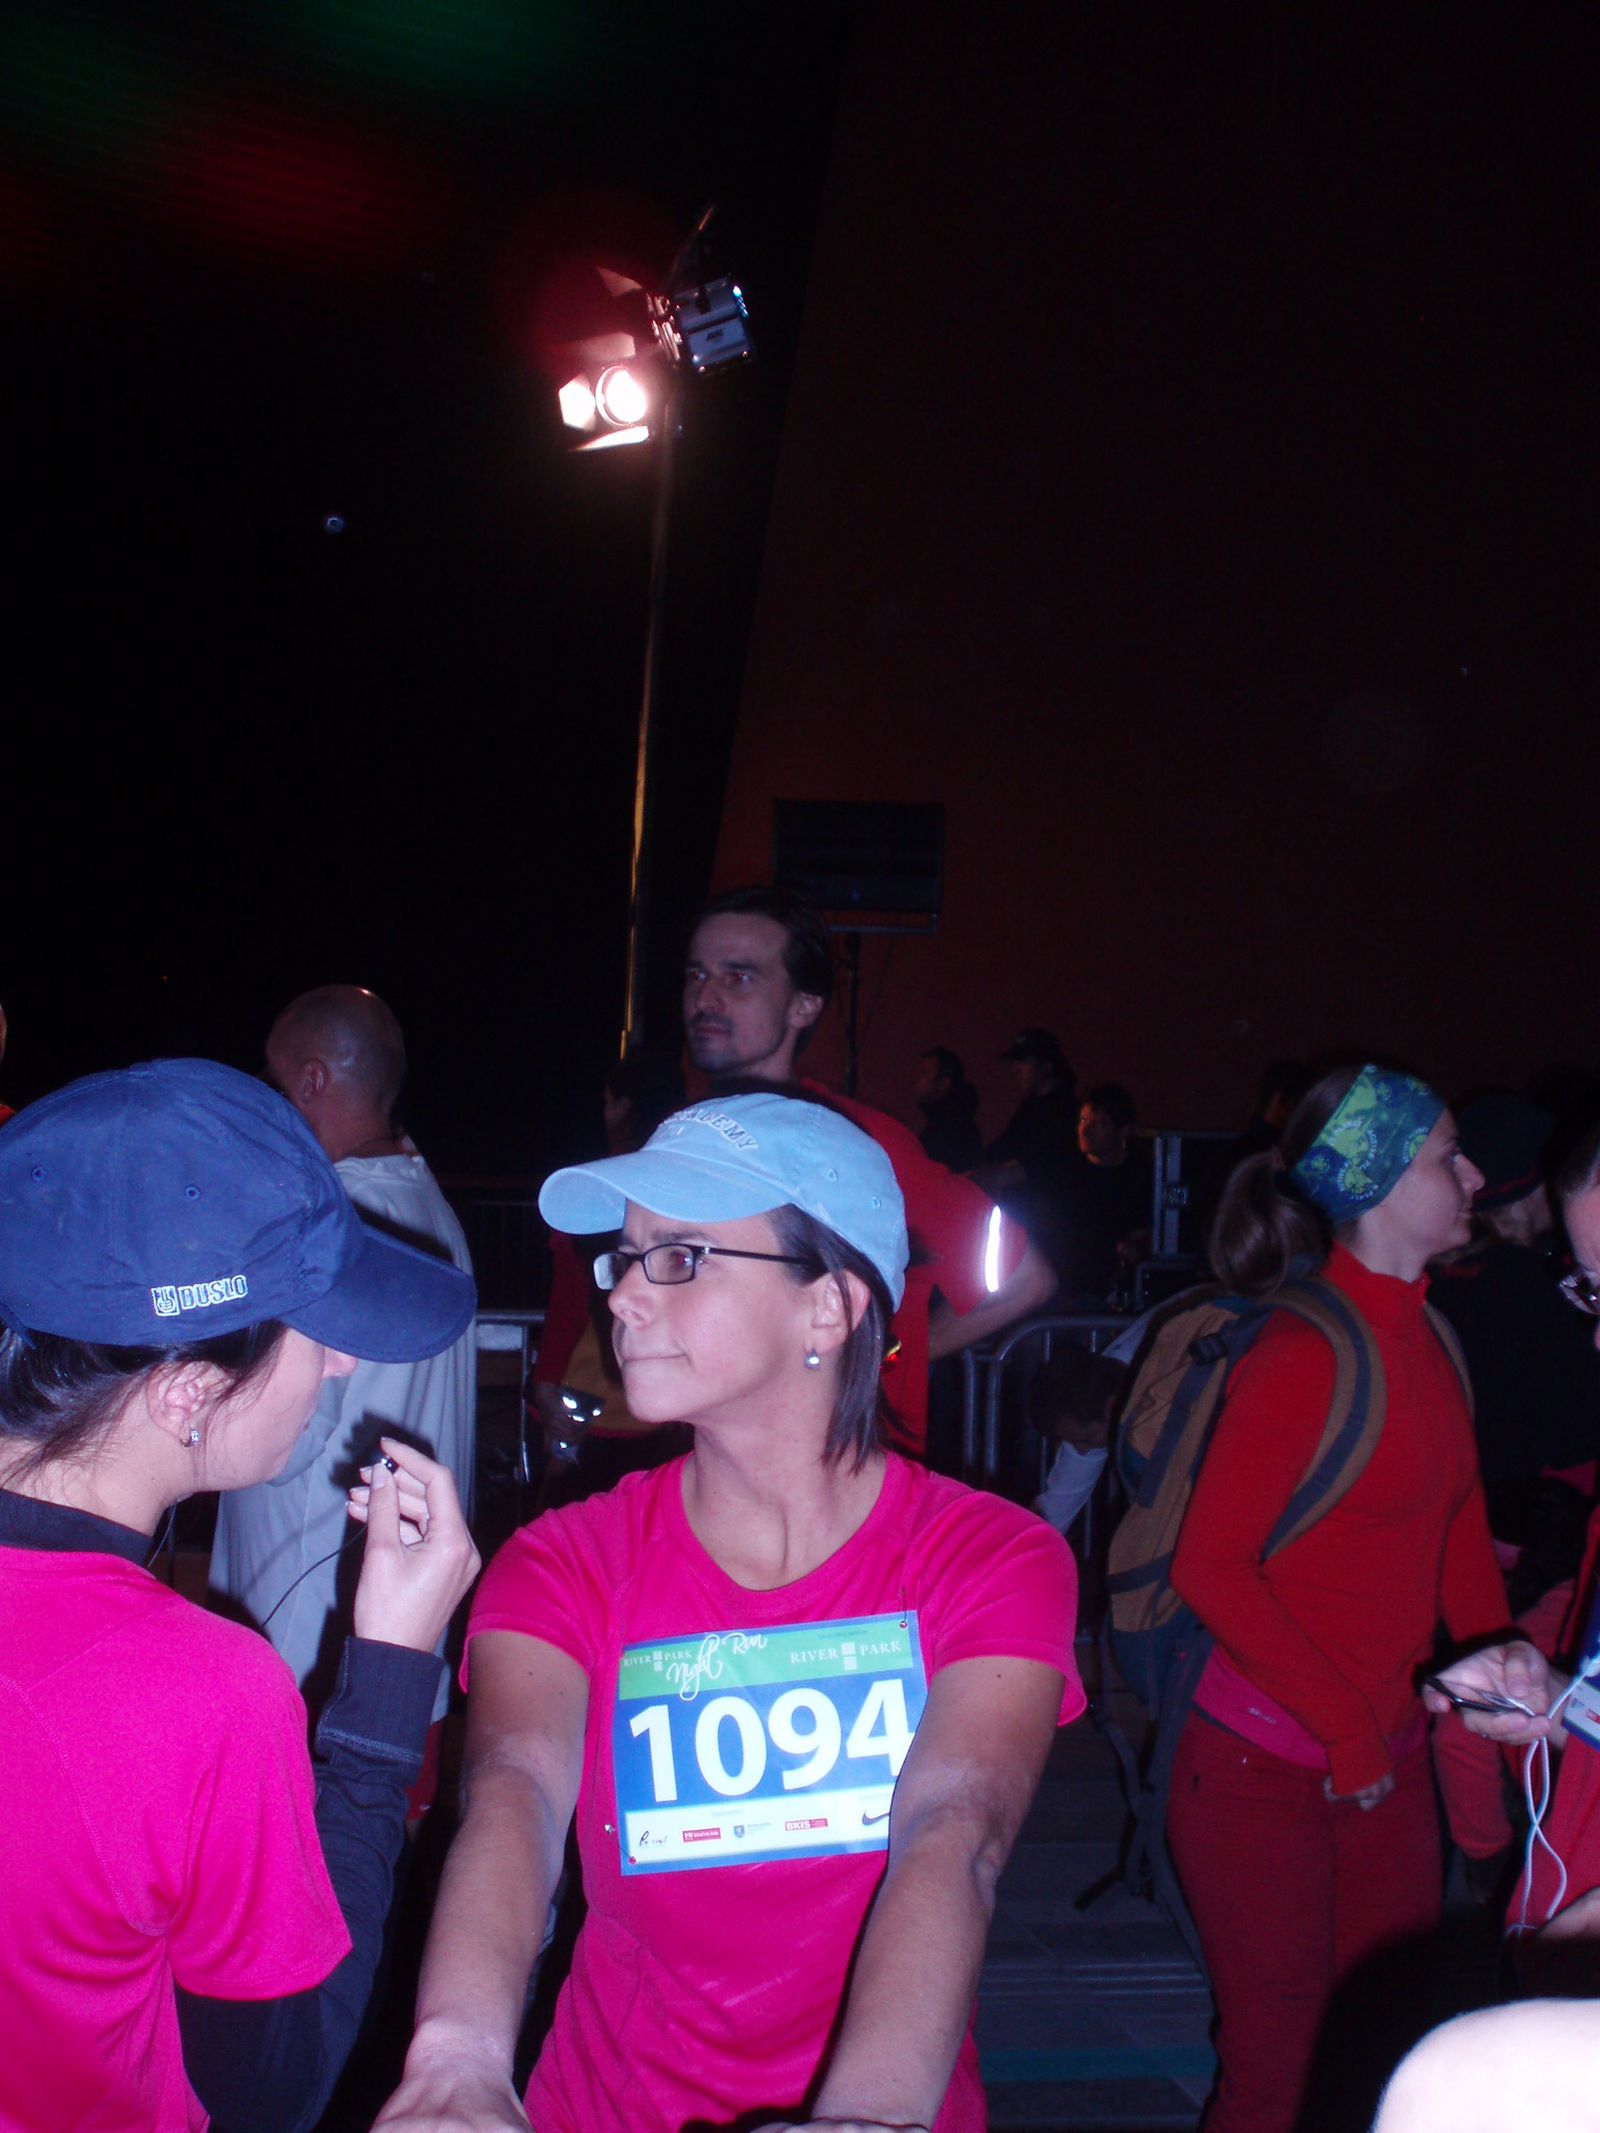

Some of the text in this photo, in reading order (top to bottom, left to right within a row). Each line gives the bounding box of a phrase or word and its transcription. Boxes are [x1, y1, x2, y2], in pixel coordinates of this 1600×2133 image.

[178, 1274, 248, 1310] DUSLO
[623, 1649, 693, 1667] RIVER PARK
[666, 1632, 768, 1701] Night Run
[790, 1640, 902, 1665] RIVER PARK
[629, 1678, 917, 1803] 1094
